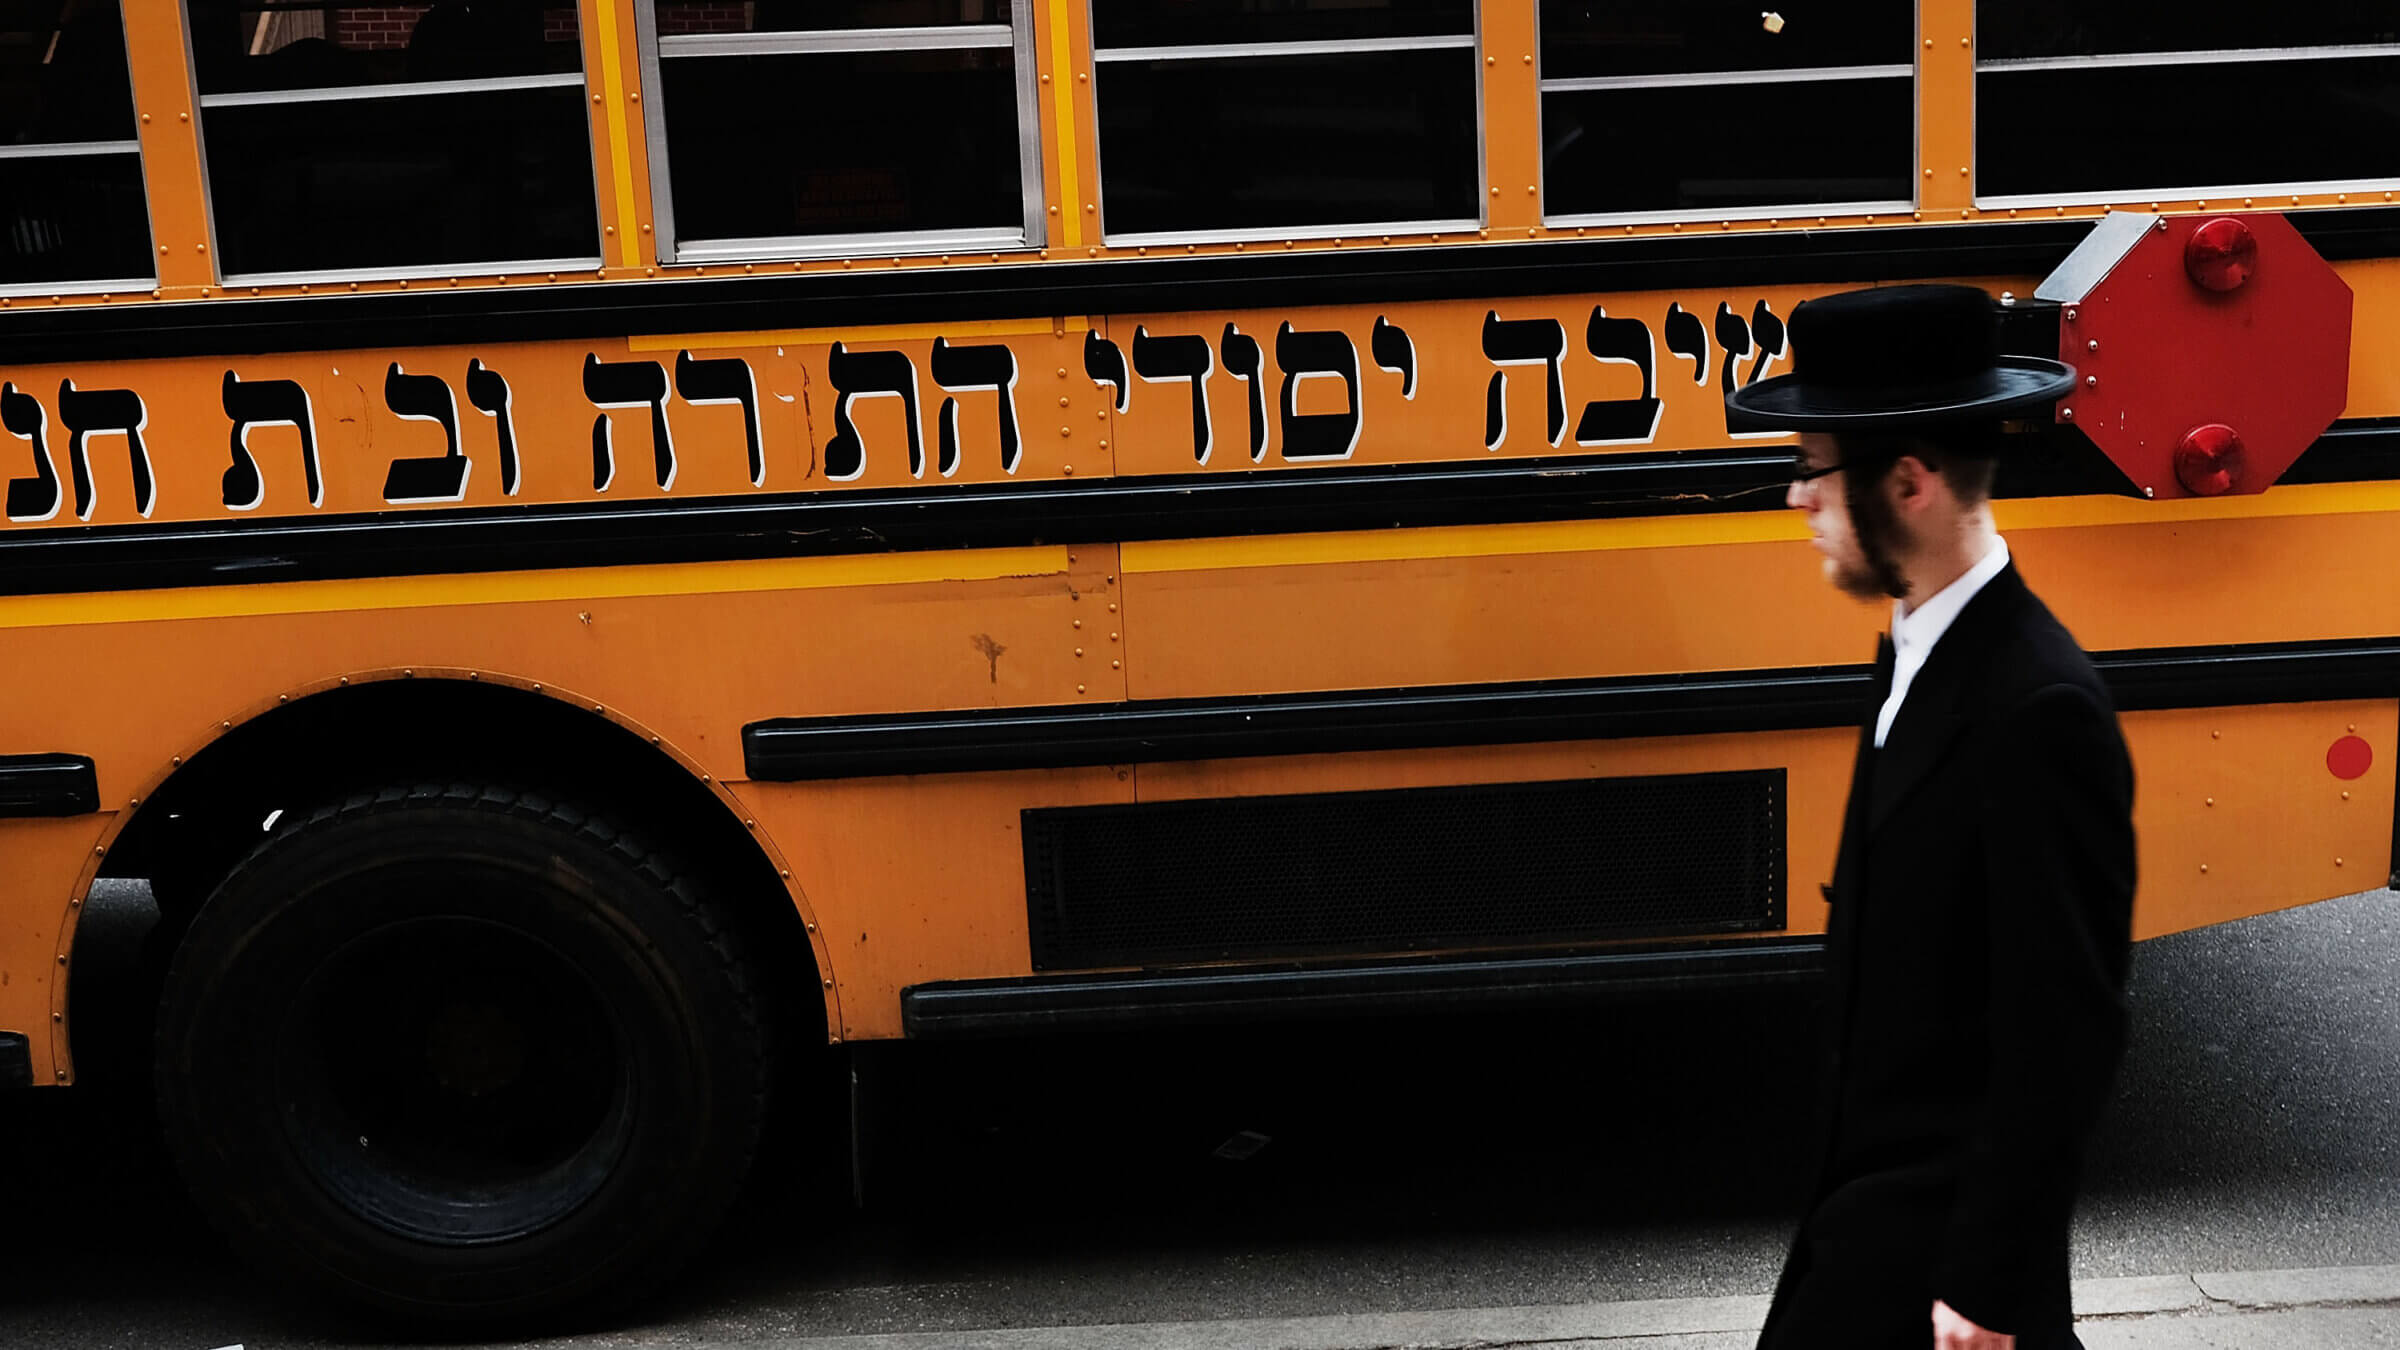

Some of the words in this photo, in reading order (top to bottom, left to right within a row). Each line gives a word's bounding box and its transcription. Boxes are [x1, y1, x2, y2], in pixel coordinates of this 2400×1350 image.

[222, 358, 520, 511] ובת
[583, 336, 1022, 492] התרה
[1084, 315, 1417, 466] יסודי
[1482, 298, 1806, 451] שיבה
